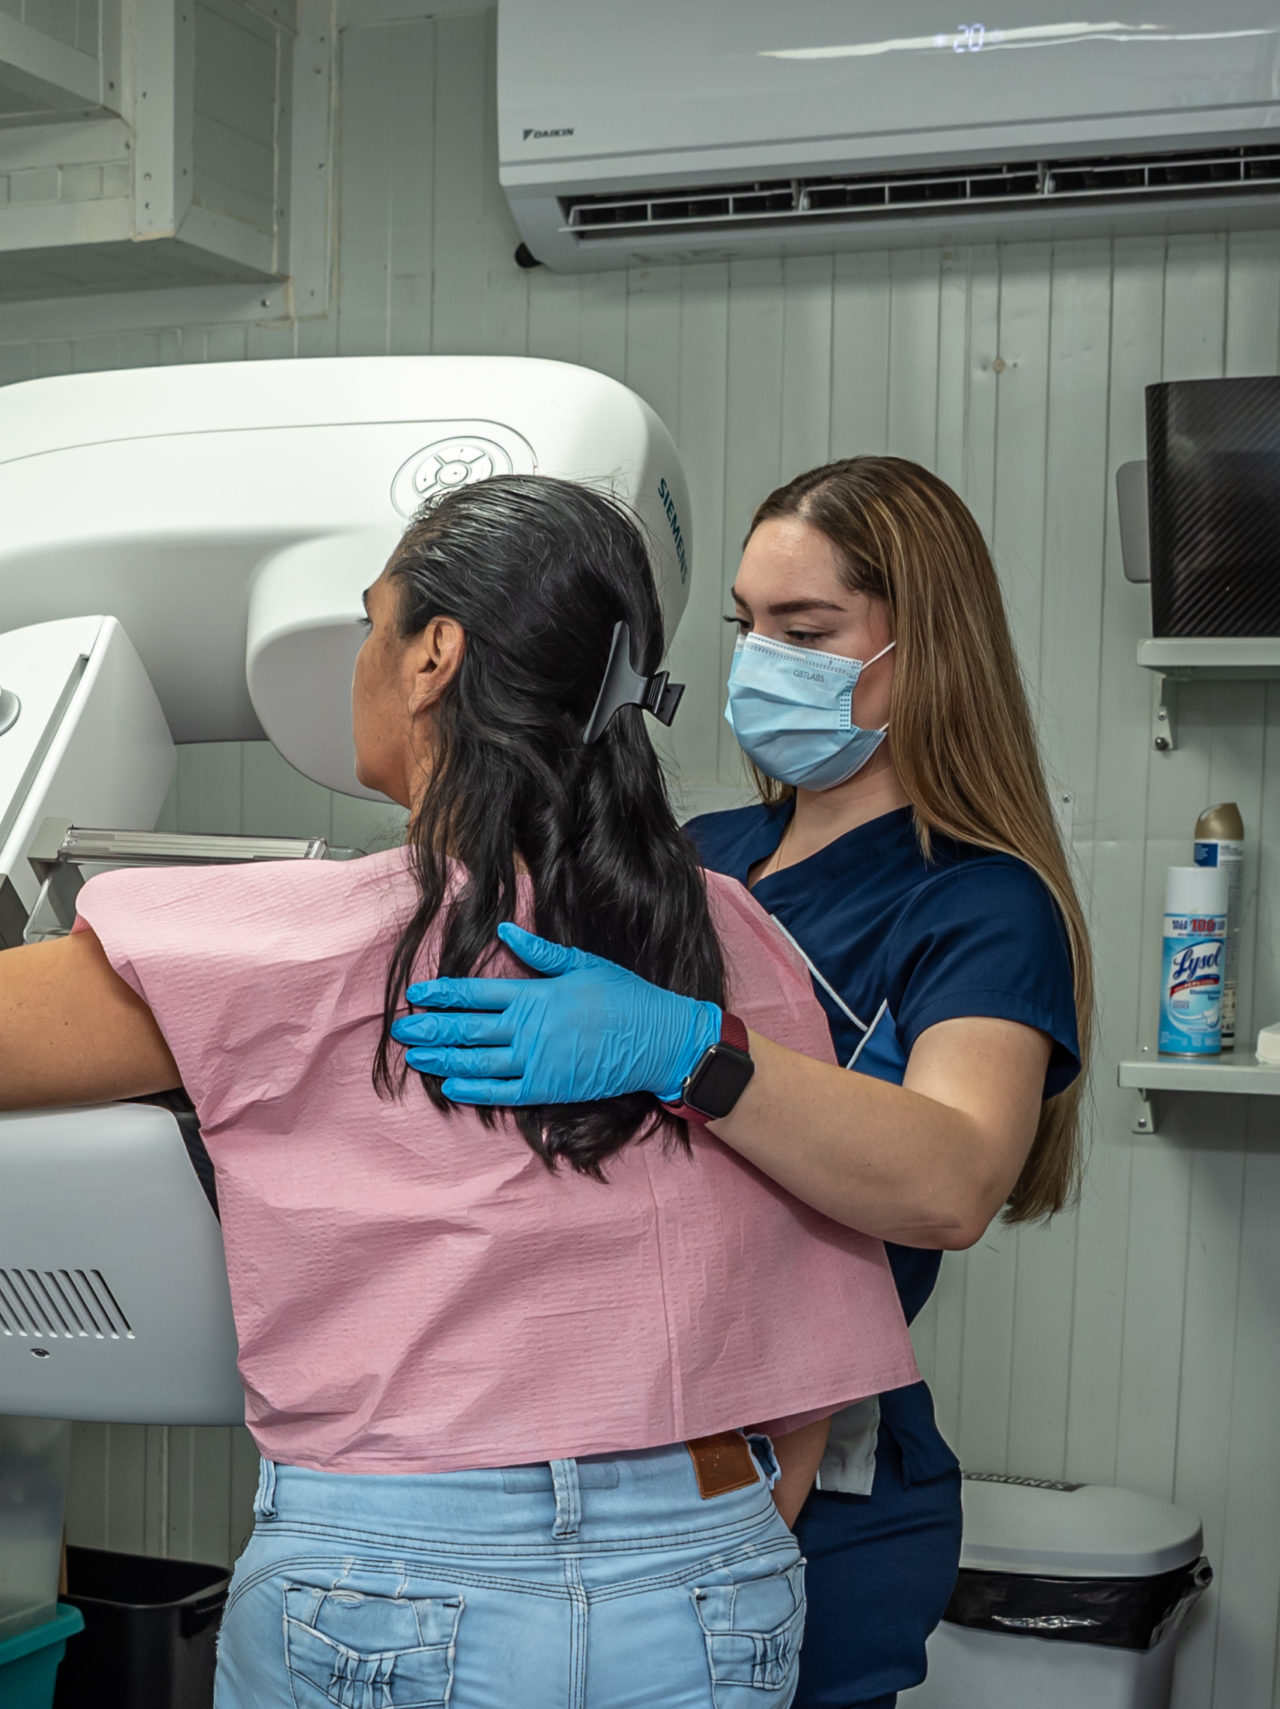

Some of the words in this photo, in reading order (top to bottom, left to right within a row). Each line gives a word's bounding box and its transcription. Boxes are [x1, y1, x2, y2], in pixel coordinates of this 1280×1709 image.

[952, 23, 985, 53] 20
[533, 127, 575, 140] DAIKIN
[657, 477, 689, 586] SIEMENS
[1173, 944, 1222, 980] Lysol
